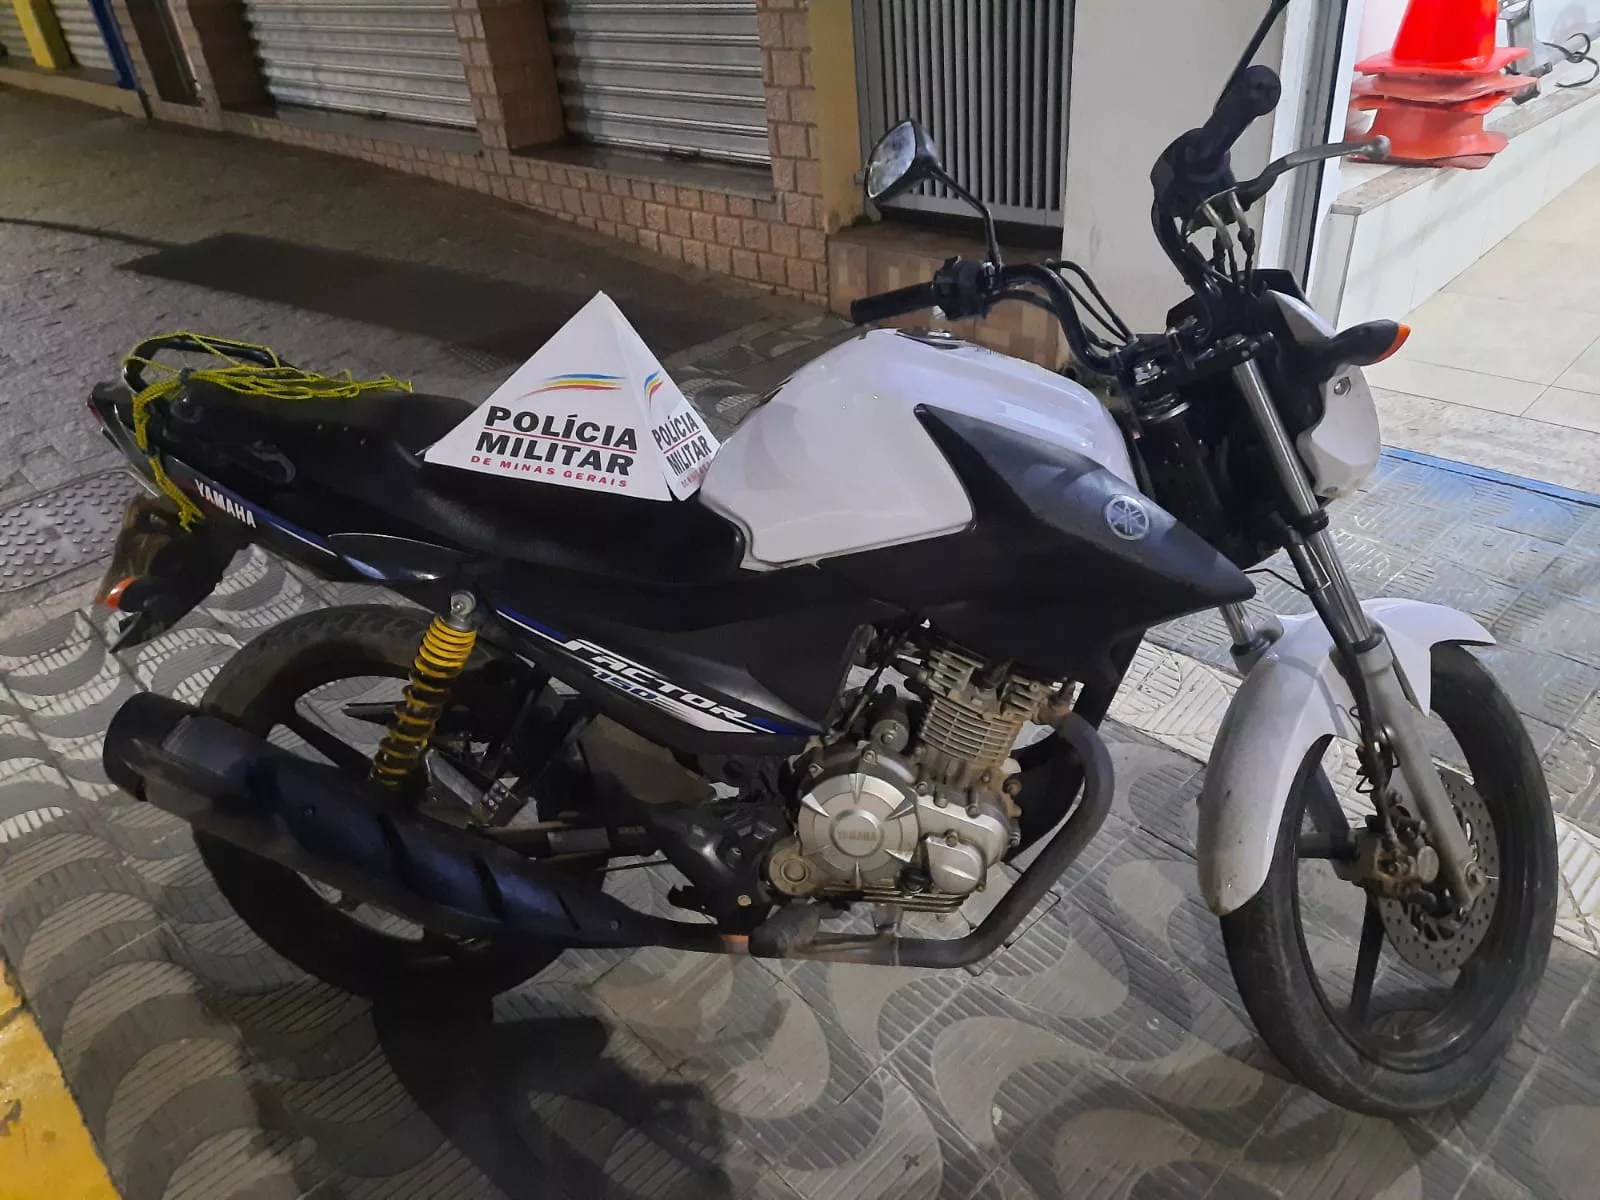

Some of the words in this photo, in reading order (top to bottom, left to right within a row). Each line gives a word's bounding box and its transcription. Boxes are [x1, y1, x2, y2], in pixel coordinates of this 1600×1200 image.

[485, 405, 638, 451] POLÍCIA
[651, 411, 700, 451] POLÍCIA
[470, 455, 492, 466] DE
[499, 460, 556, 475] MINAS
[563, 470, 628, 488] GERAIS
[475, 431, 634, 476] MILITAR
[666, 435, 712, 477] MILITAR
[194, 478, 257, 529] YAMAHA
[562, 638, 756, 722] FACTOR
[596, 669, 659, 701] 150
